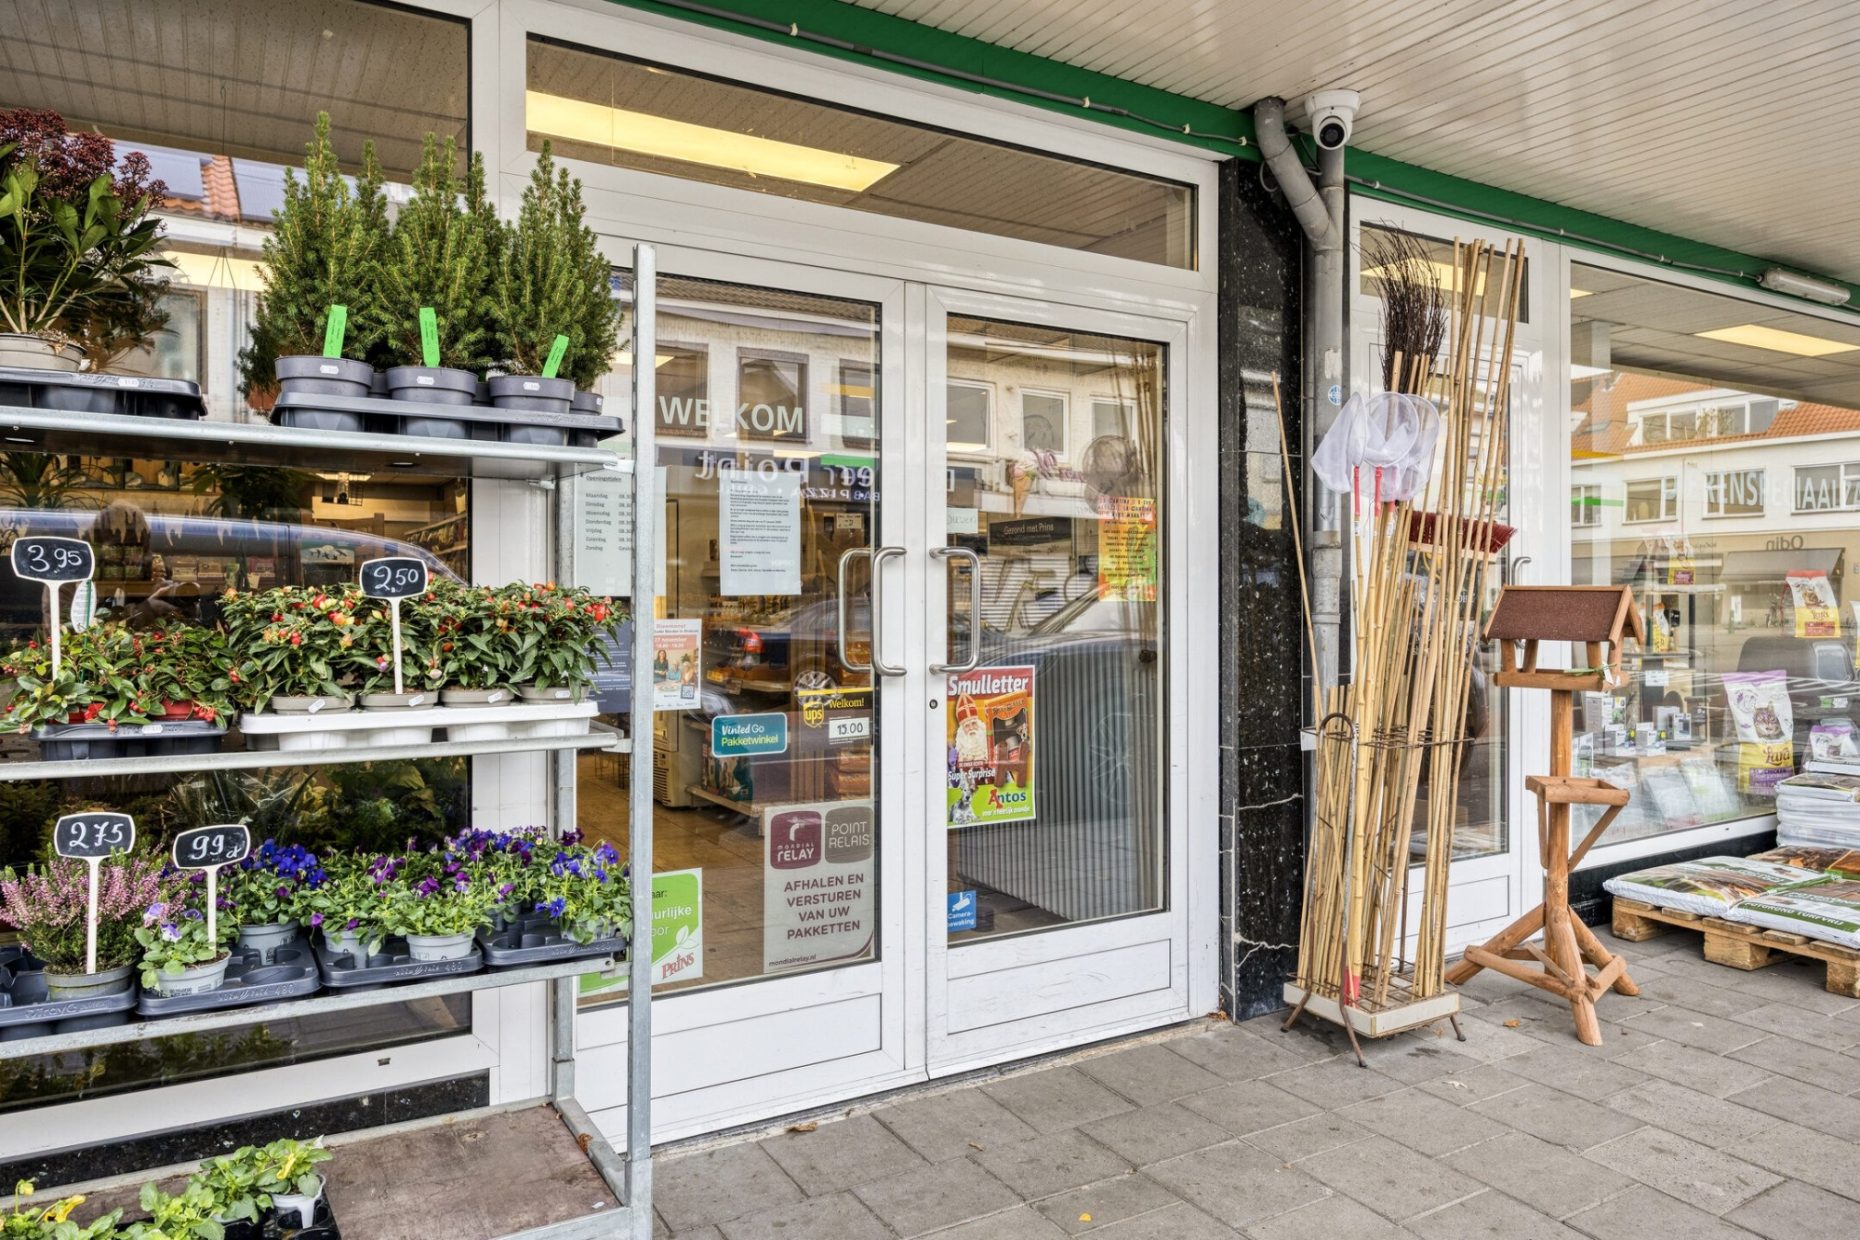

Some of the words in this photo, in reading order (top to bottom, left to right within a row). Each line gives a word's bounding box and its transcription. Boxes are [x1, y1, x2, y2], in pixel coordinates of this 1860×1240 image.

[658, 395, 803, 433] WELKOM
[947, 674, 1029, 697] Smulletter
[829, 697, 865, 709] Welkom!
[805, 709, 823, 725] ups
[721, 724, 750, 736] Vinted
[751, 724, 765, 734] Go
[721, 734, 779, 747] Pakketwinkel
[988, 788, 1026, 809] Antos
[829, 834, 870, 849] RELAIS
[784, 875, 844, 893] AFHALEN
[847, 873, 864, 885] EN
[786, 888, 861, 908] VERSTUREN
[798, 909, 824, 922] VAN
[828, 905, 850, 919] UW
[787, 920, 860, 940] PAKKETTEN
[768, 954, 817, 968] mondialrelay.nl
